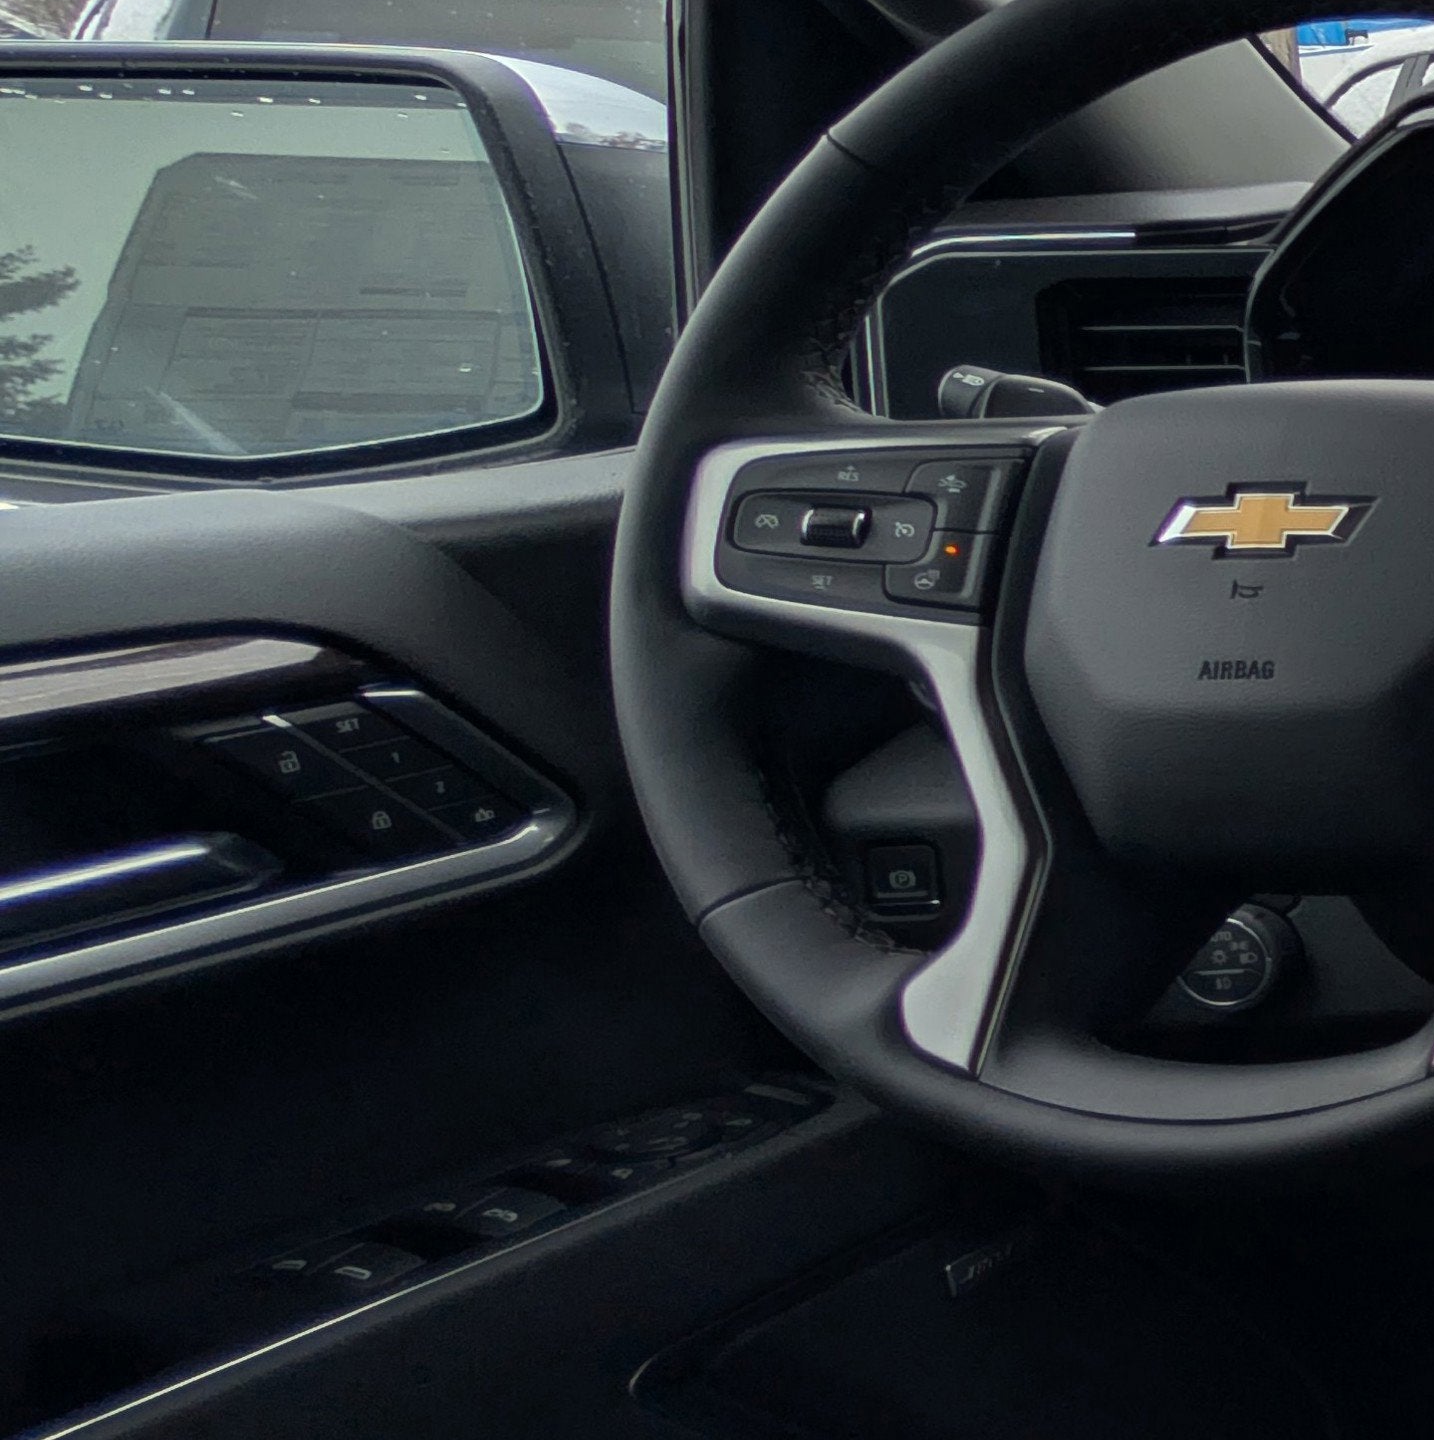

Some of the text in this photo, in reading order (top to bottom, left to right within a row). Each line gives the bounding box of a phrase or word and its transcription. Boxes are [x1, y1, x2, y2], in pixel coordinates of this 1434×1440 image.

[811, 574, 833, 584] SET
[1198, 660, 1275, 680] AIRBAG
[336, 718, 360, 733] SET
